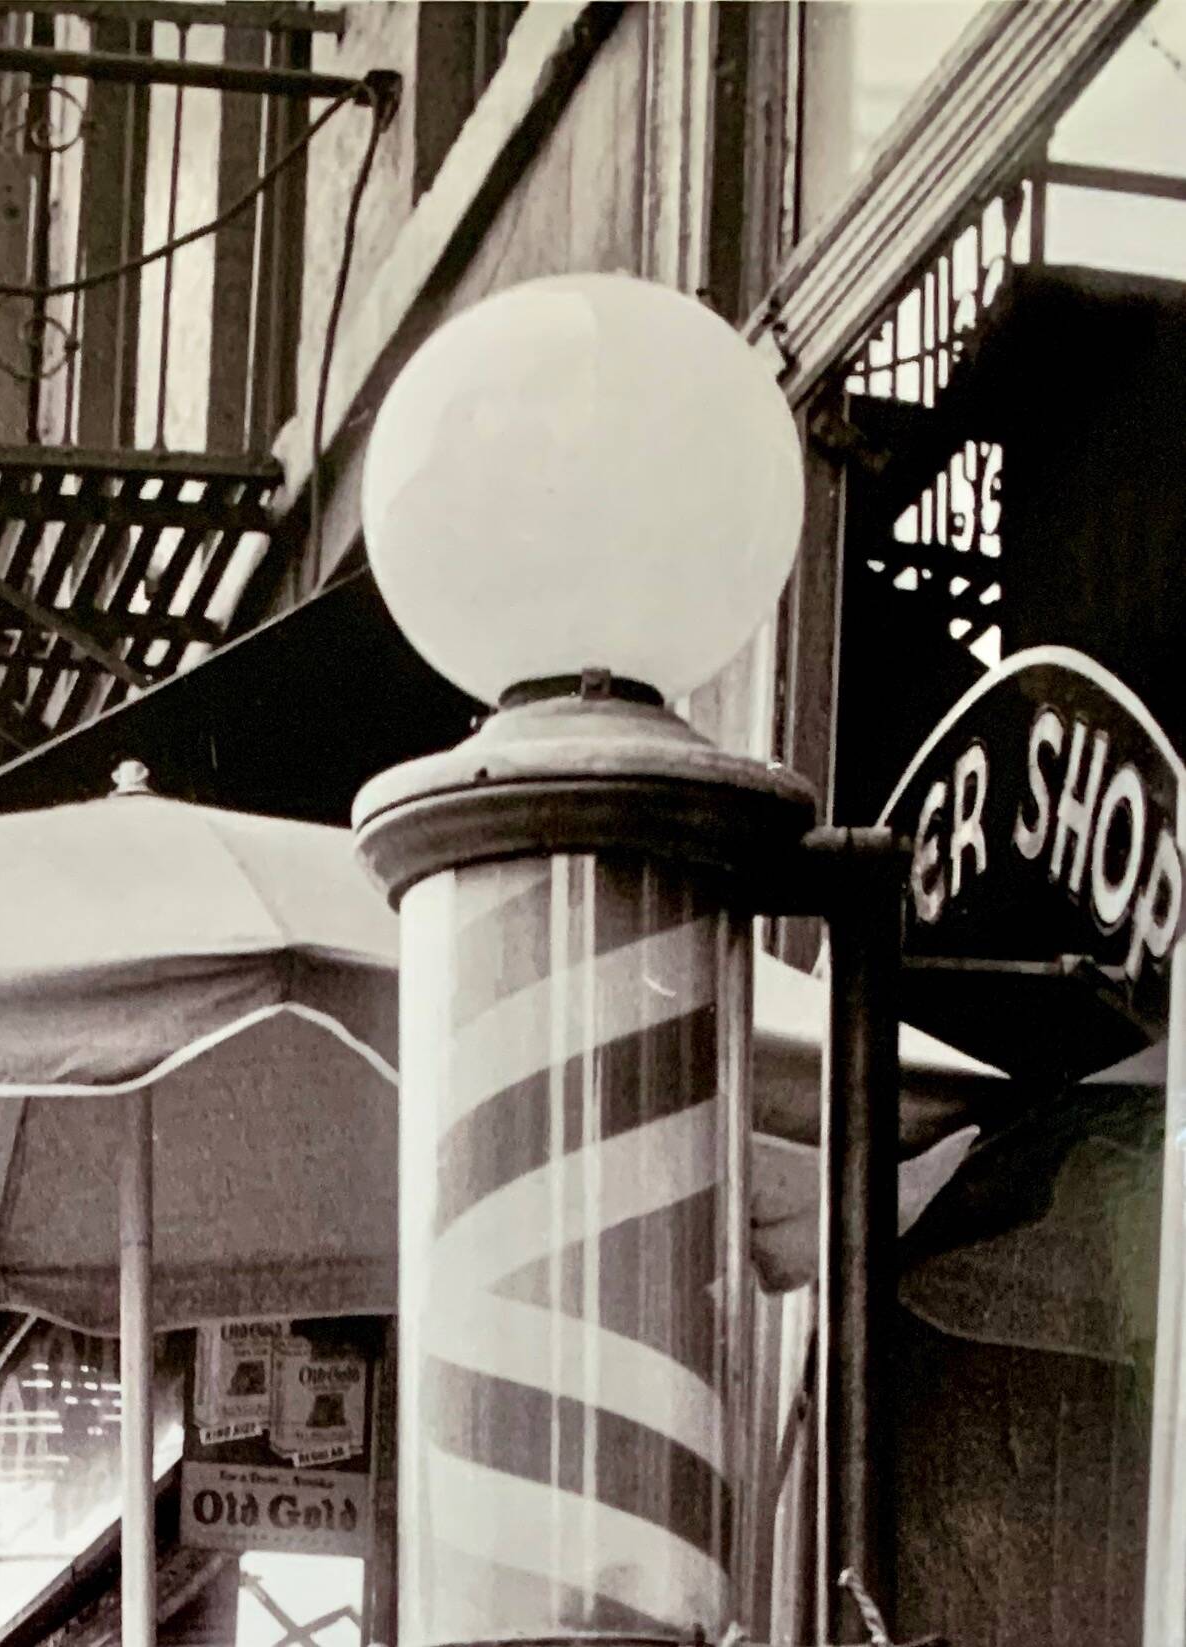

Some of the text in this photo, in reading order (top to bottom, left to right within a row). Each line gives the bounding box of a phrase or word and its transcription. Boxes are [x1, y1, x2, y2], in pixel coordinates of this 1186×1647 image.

[1014, 703, 1183, 982] SHOP
[192, 1489, 358, 1532] Old Gold
